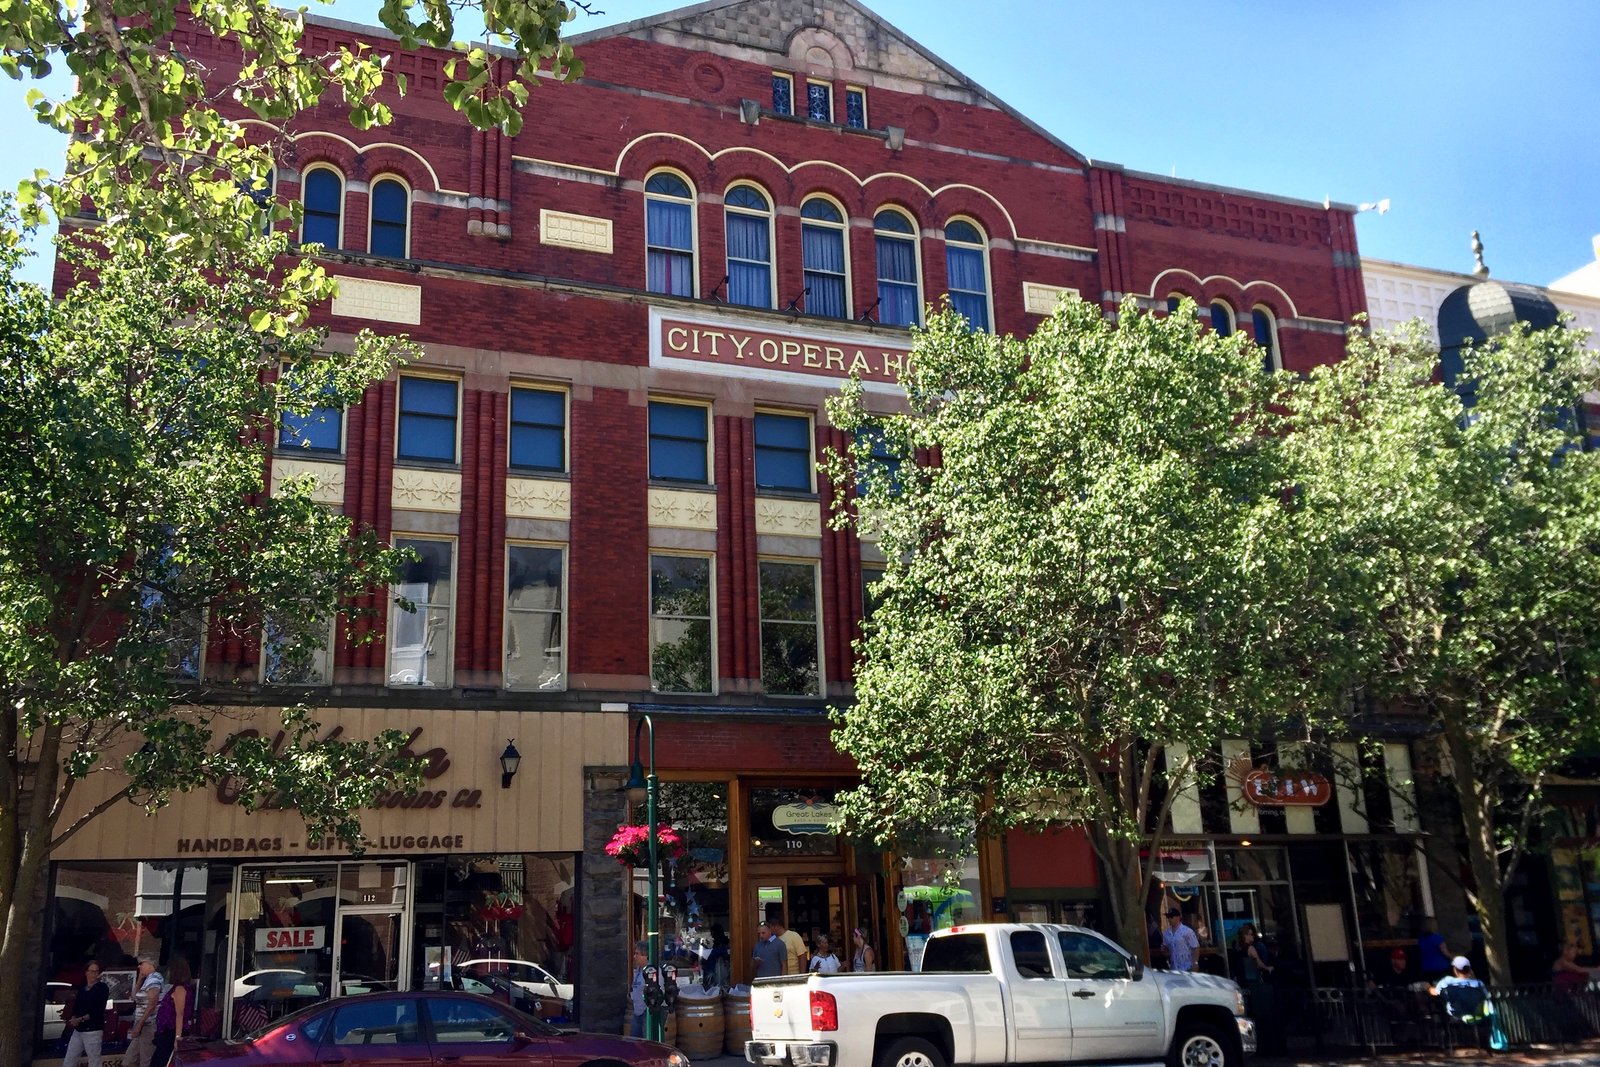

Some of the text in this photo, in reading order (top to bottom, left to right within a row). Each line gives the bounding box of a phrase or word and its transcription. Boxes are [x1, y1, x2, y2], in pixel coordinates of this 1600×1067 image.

[667, 327, 751, 359] CITY
[759, 339, 872, 374] OPERA
[786, 810, 832, 818] Great Lakes
[177, 837, 282, 853] HANDBAGS
[307, 836, 356, 851] GIFT
[380, 835, 464, 850] LUGGAGE
[785, 840, 803, 849] 110
[363, 894, 376, 902] 112
[266, 930, 315, 949] SALE
